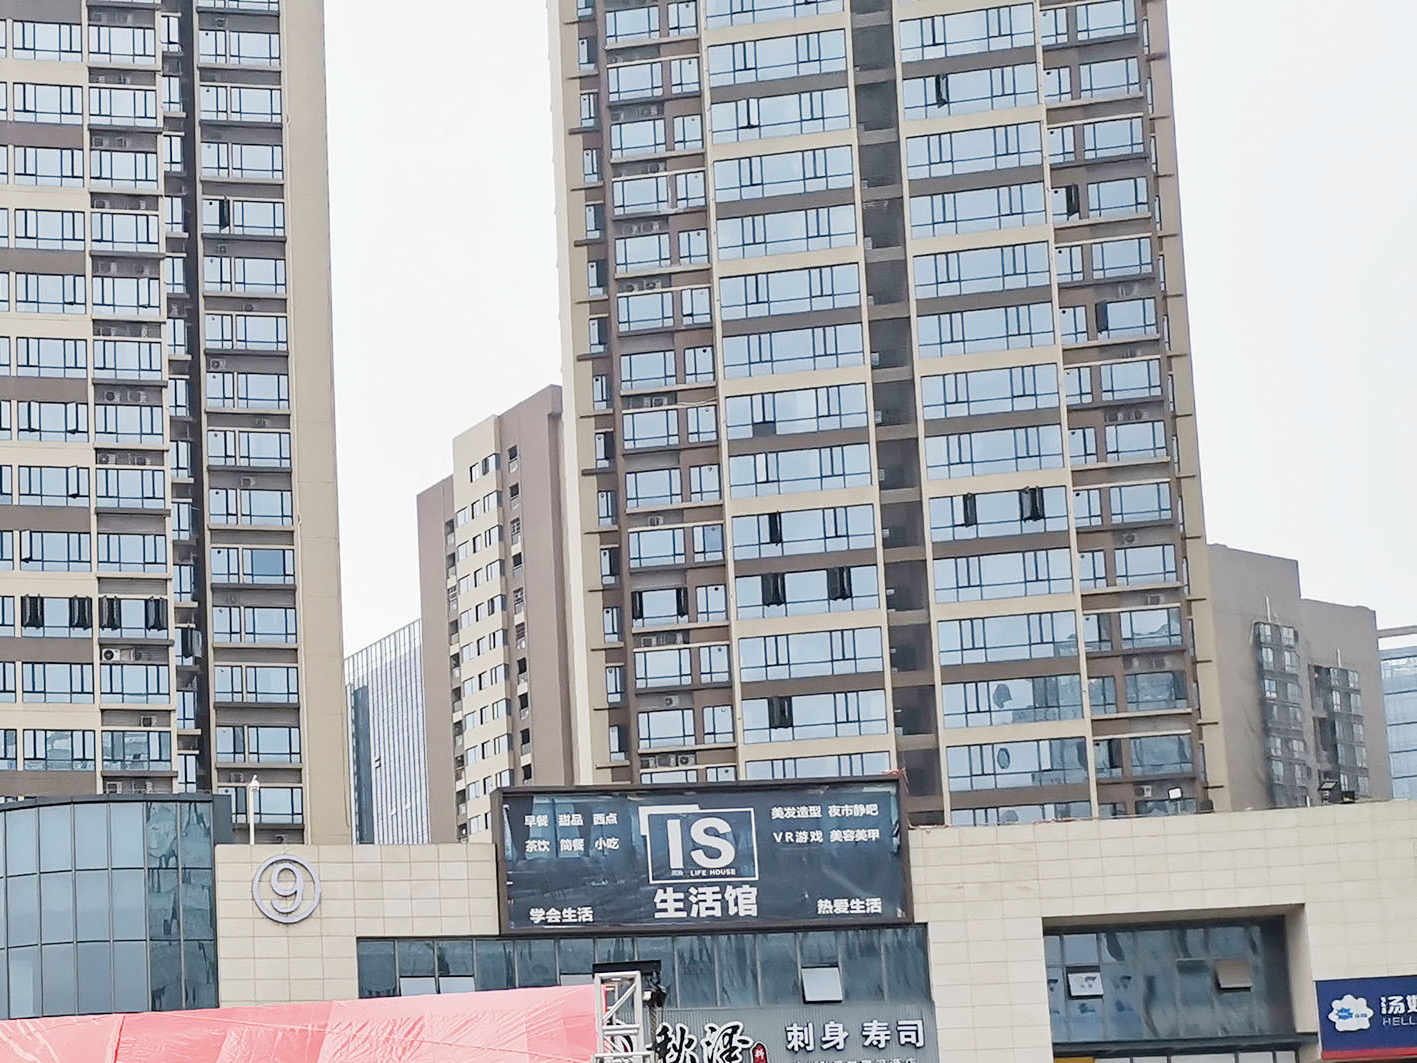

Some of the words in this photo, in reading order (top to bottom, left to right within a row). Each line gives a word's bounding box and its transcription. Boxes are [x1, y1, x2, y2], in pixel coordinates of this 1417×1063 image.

[525, 815, 548, 828] 早餐
[558, 813, 583, 826] 甜品
[593, 813, 618, 826] 西点
[771, 806, 822, 819] 美发造型
[667, 817, 735, 868] IS
[830, 829, 880, 842] 美容美甲
[525, 840, 550, 852] 茶饮
[560, 838, 584, 851] 简餐
[594, 837, 620, 850] 小吃
[654, 885, 758, 918] 生活馆
[817, 898, 882, 914] 热爱生活
[529, 907, 594, 923] 学会生活
[786, 1021, 849, 1051] 刺身
[862, 1018, 924, 1049] 寿司
